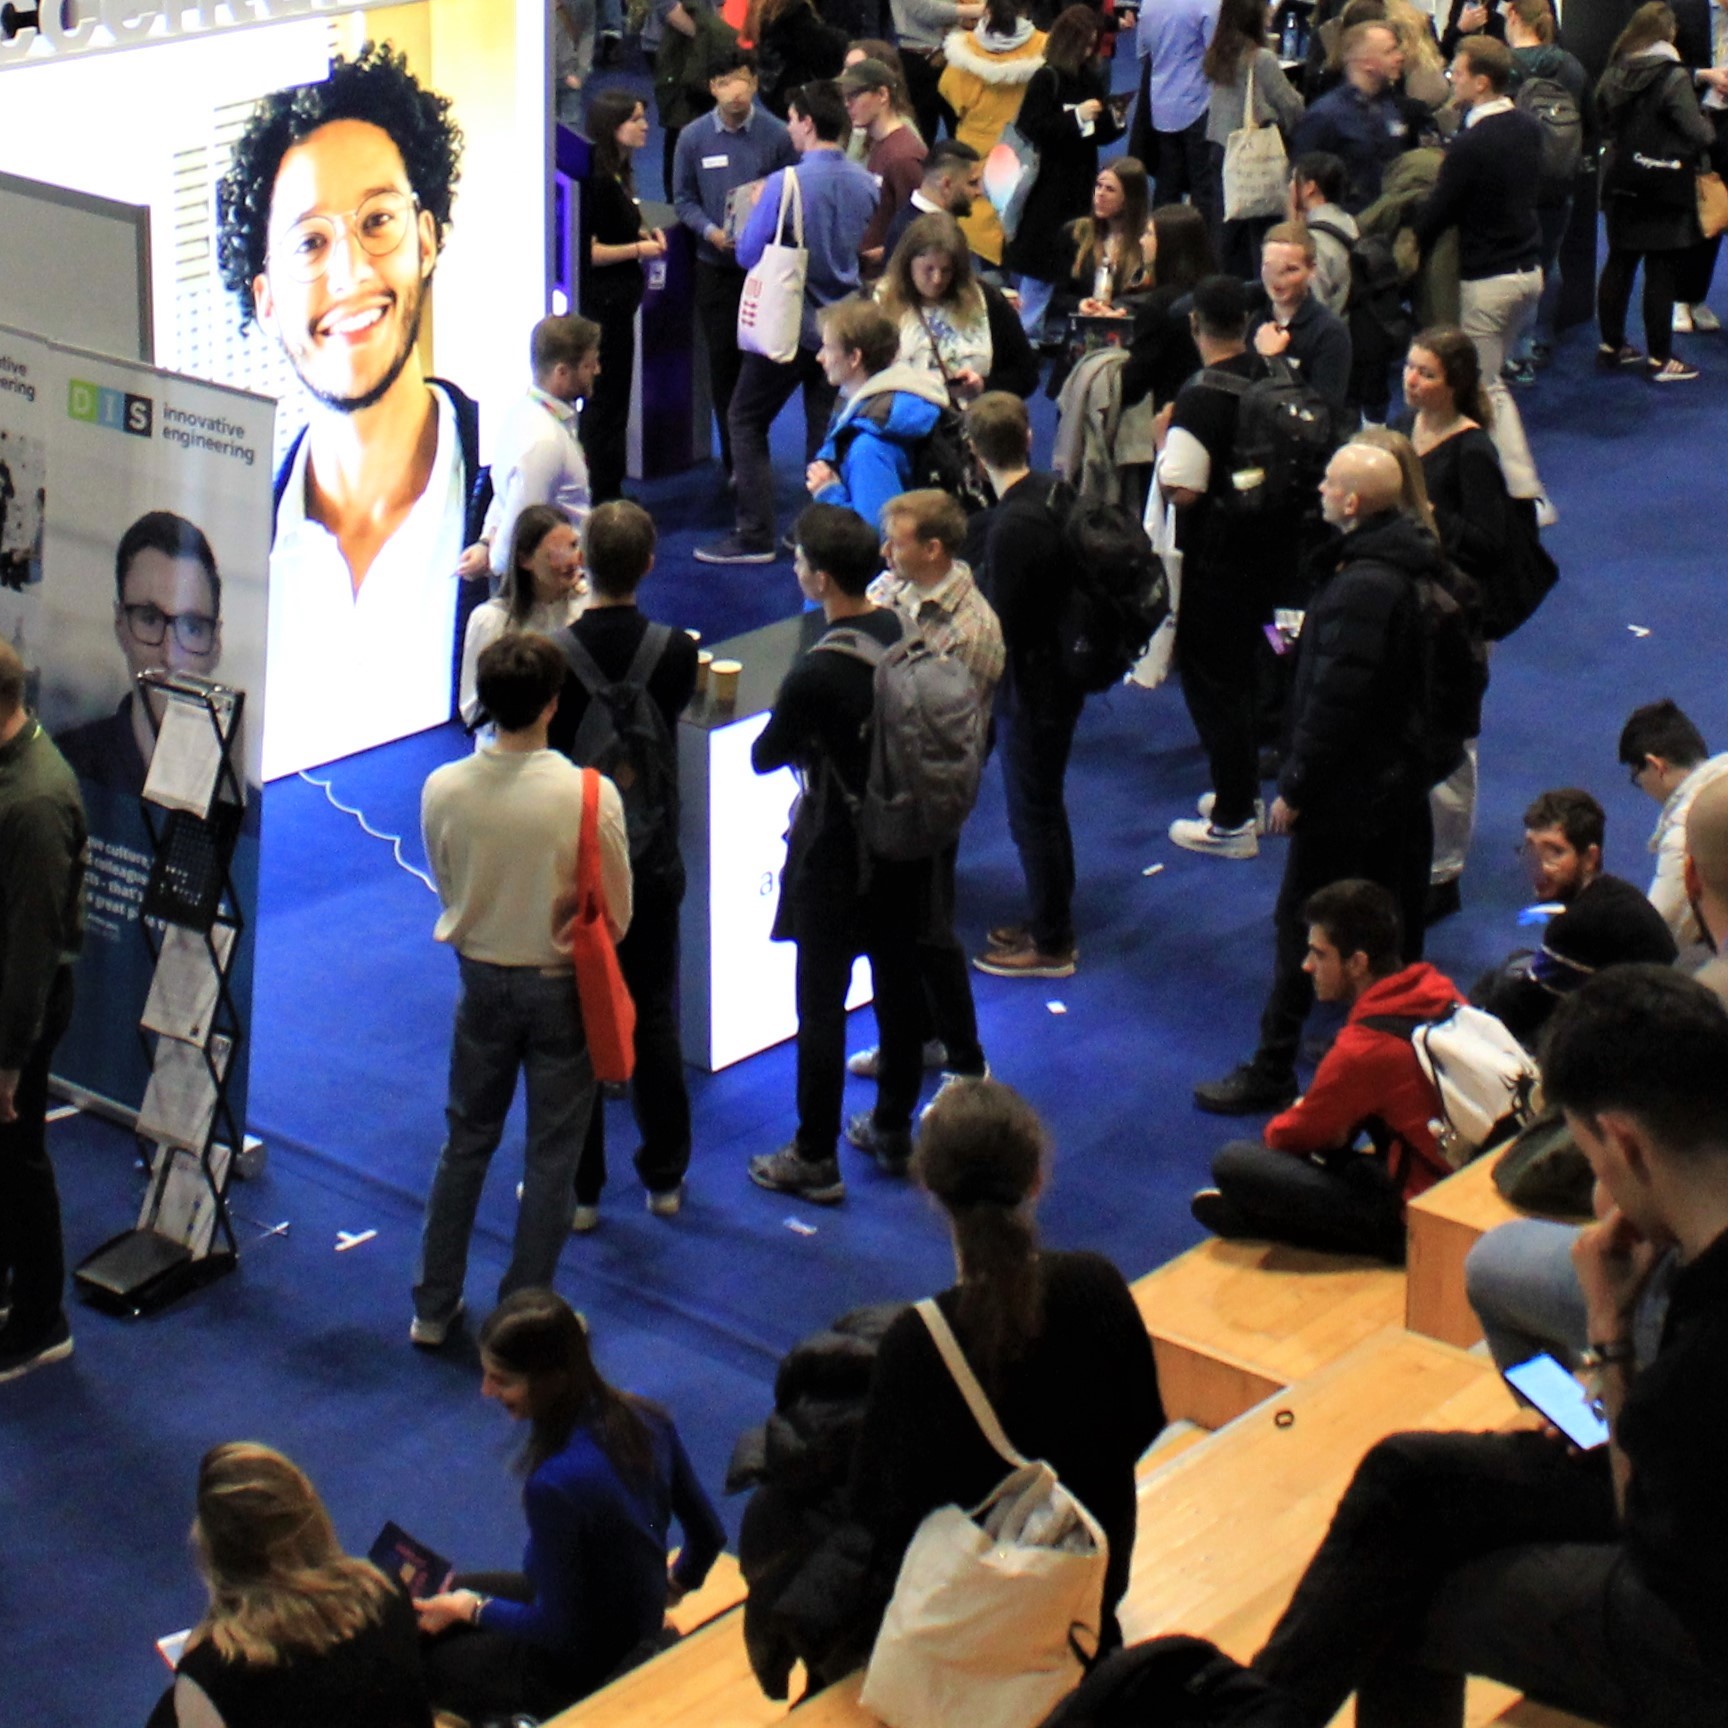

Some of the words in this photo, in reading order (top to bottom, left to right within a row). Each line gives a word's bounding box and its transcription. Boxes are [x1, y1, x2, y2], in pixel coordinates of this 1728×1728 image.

[73, 389, 147, 431] DIS
[163, 402, 245, 439] innovative
[163, 425, 255, 465] engineering
